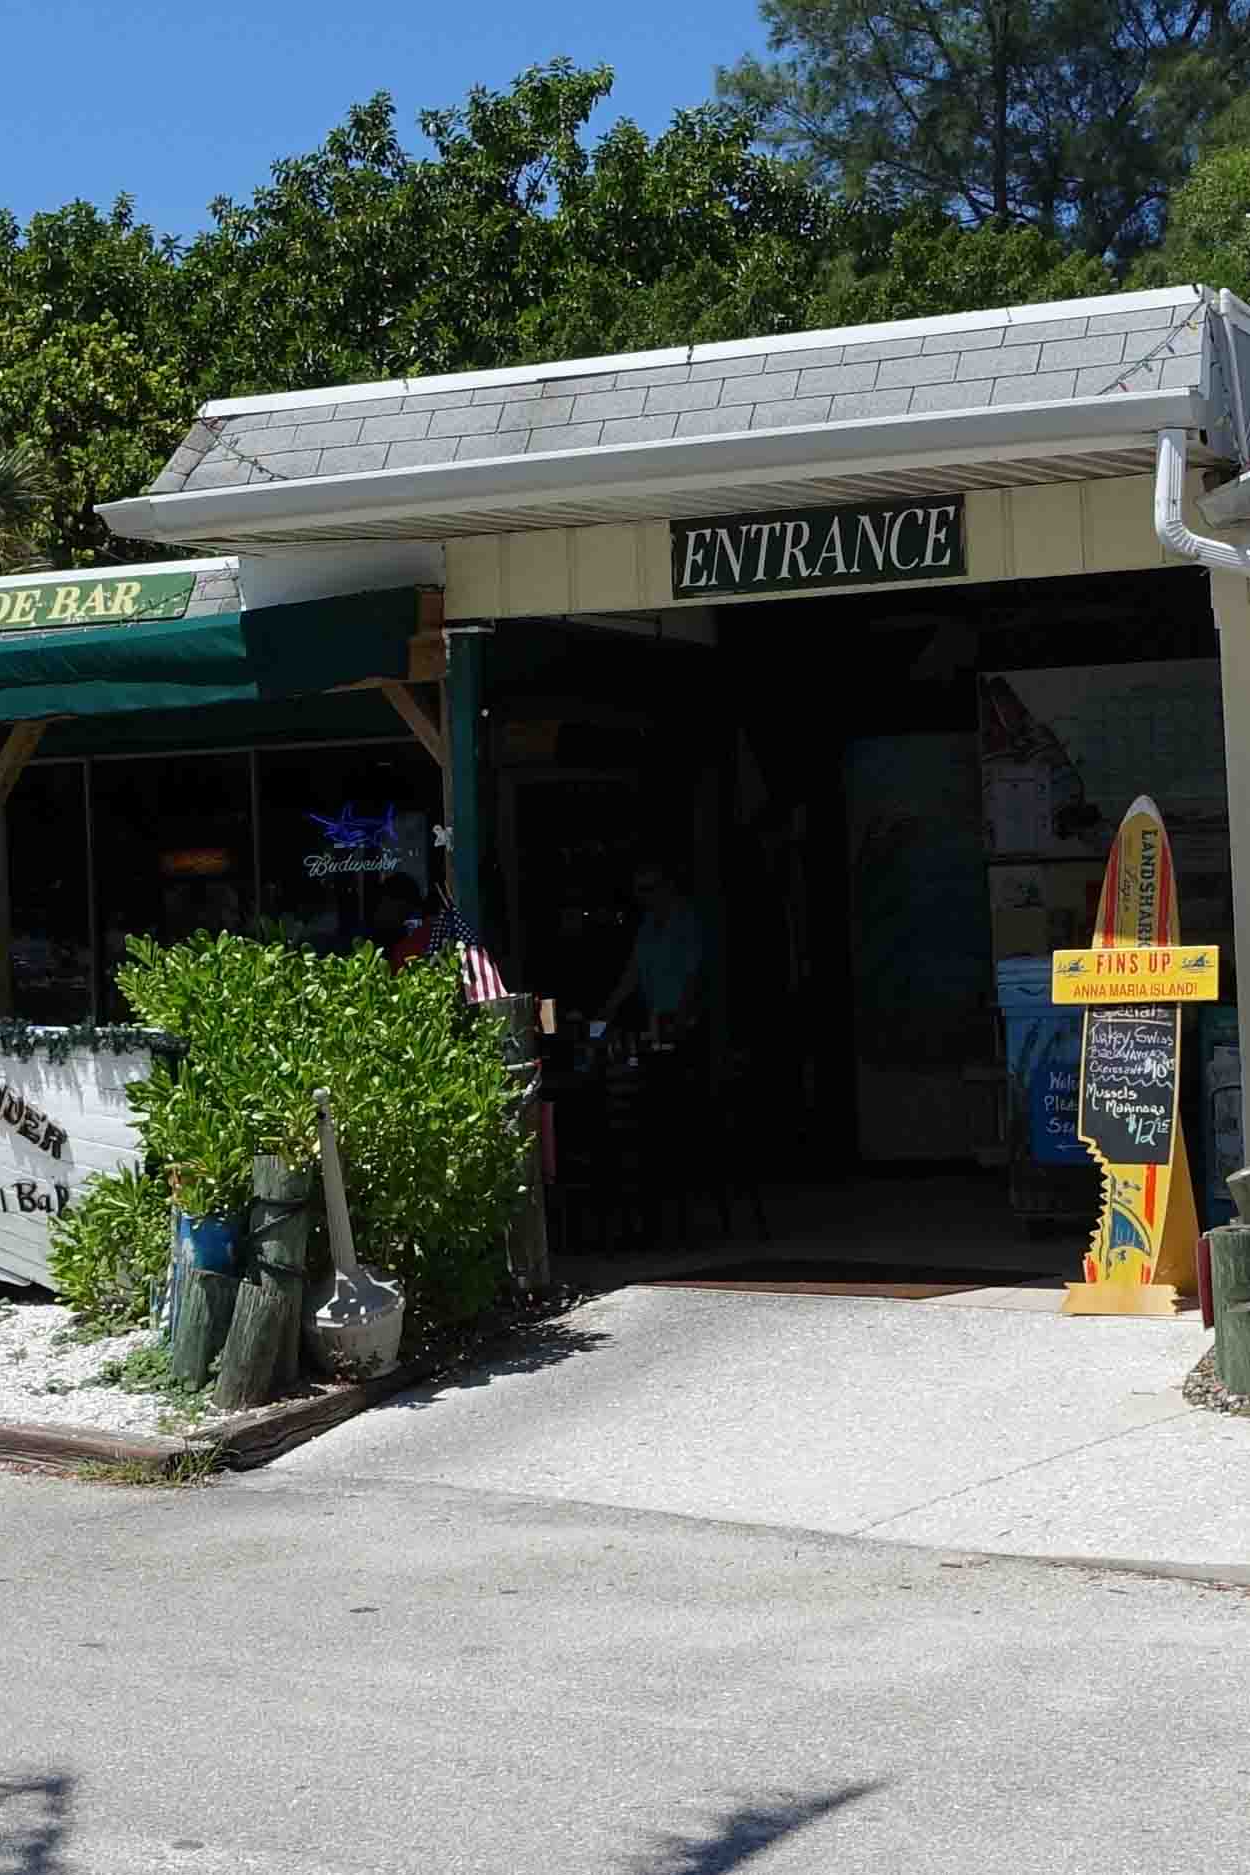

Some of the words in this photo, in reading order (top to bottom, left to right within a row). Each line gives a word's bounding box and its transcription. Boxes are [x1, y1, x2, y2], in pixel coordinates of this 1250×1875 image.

[680, 505, 957, 589] ENTRANCE
[49, 580, 142, 619] BAR
[303, 850, 399, 877] Budweiser
[1137, 829, 1159, 948] LANDSHARK
[1096, 952, 1140, 976] FINS
[1149, 952, 1172, 975] UP
[1073, 983, 1108, 998] ANNA
[1109, 982, 1147, 998] MARIA
[1148, 981, 1198, 997] ISLAND!
[1086, 1083, 1138, 1111] Mussels
